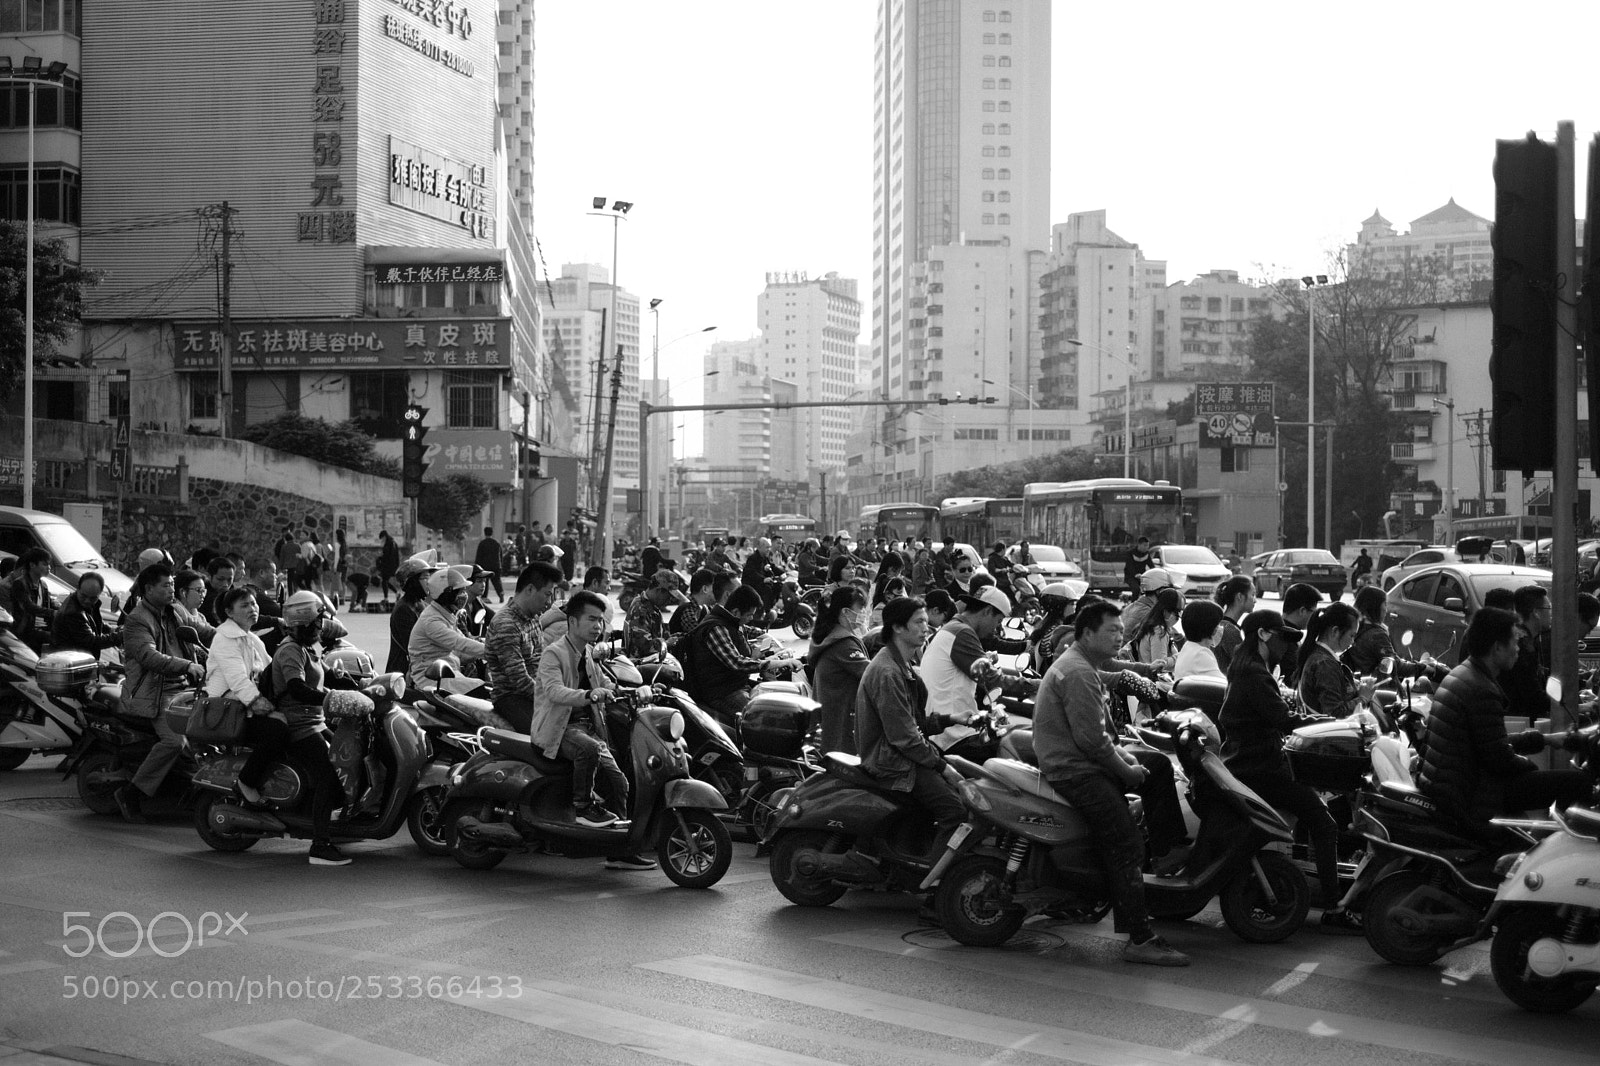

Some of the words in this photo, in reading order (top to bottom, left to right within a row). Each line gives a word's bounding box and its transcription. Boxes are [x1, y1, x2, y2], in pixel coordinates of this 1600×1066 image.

[404, 322, 496, 347] 真皮斑
[402, 349, 500, 364] 一次性祛除
[1211, 419, 1226, 429] 40
[827, 819, 845, 829] ZR
